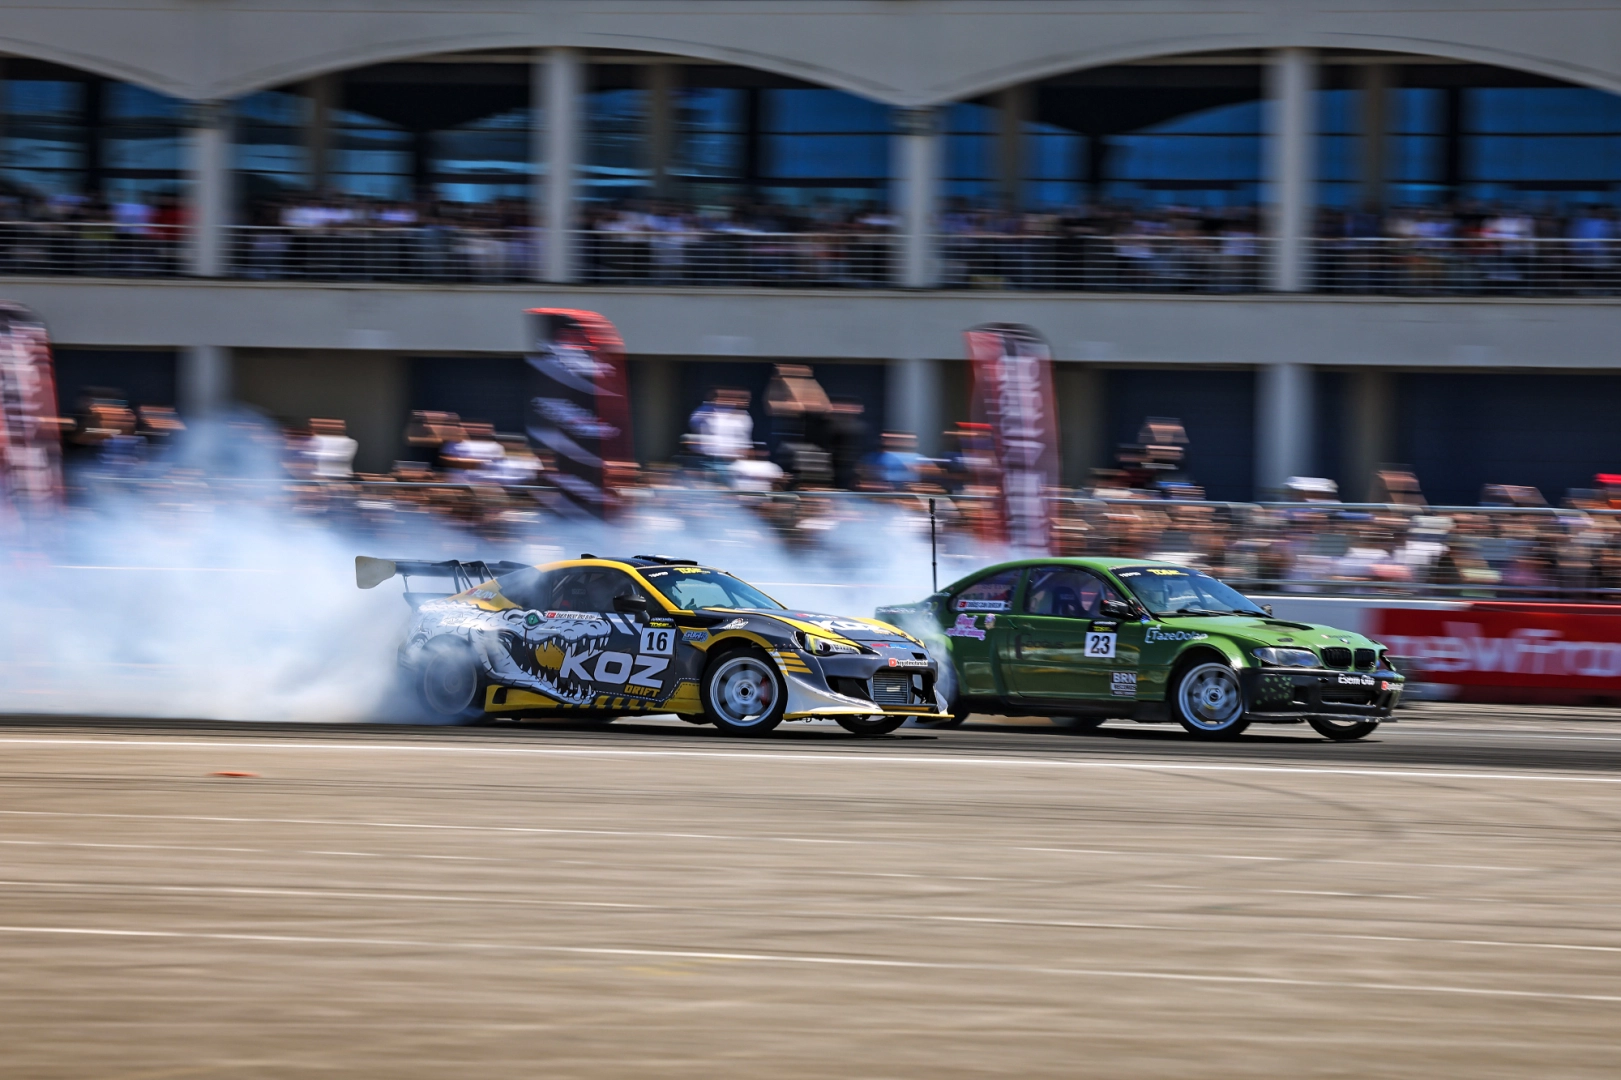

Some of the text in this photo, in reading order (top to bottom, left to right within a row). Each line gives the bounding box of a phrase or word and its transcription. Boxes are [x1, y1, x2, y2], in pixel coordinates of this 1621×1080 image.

[647, 631, 668, 651] 16
[1091, 635, 1111, 654] 23
[560, 646, 670, 689] KOZ
[1113, 672, 1137, 683] BRN
[624, 684, 660, 697] DRIFT
